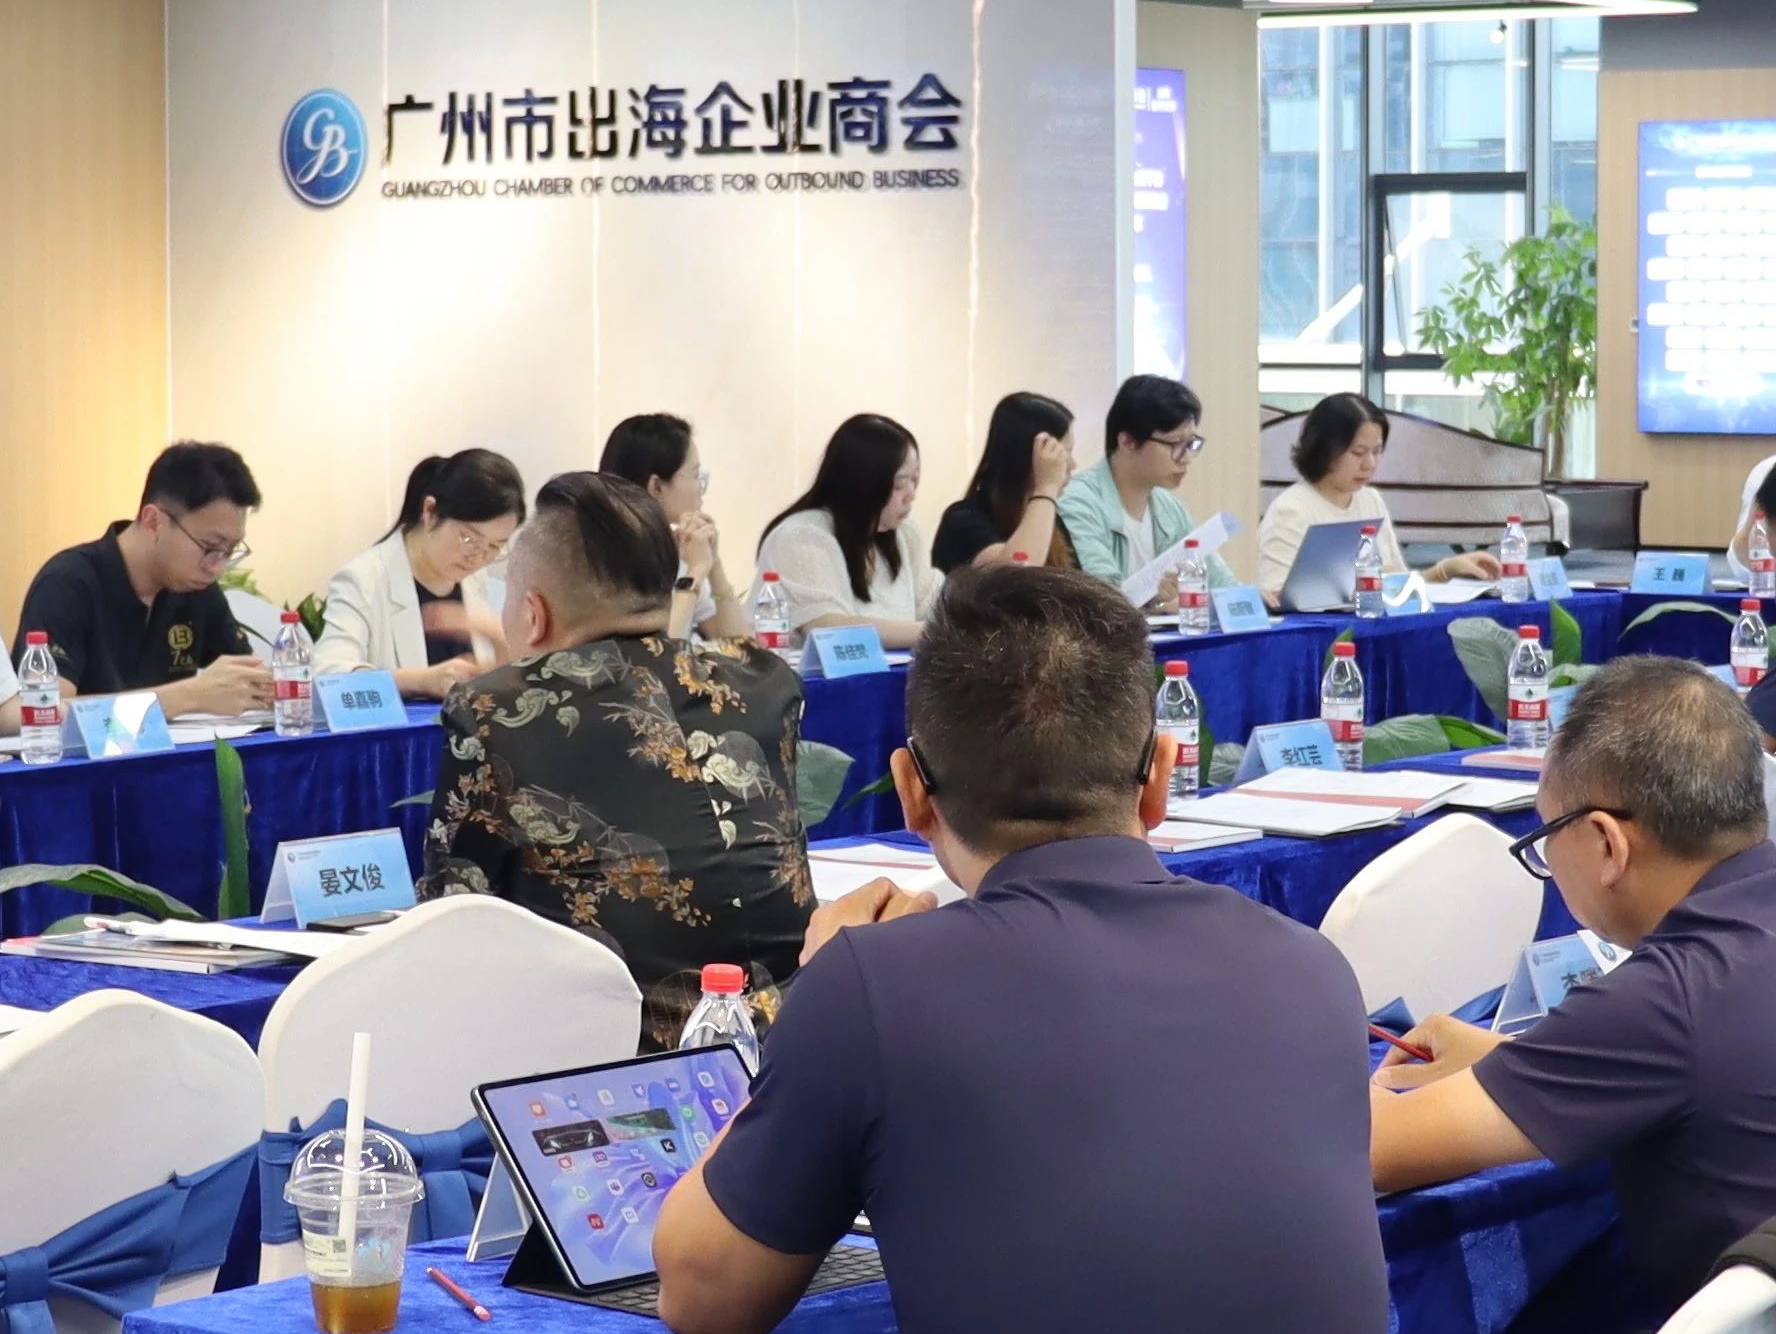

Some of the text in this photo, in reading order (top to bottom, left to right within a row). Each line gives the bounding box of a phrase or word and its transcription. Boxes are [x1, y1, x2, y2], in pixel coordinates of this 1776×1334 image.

[384, 72, 962, 165] 广州市出海企业商会
[381, 168, 960, 198] GUANGZHOU CHAMBER OF COMMERCE FOR OUTBOUND BUSINESS
